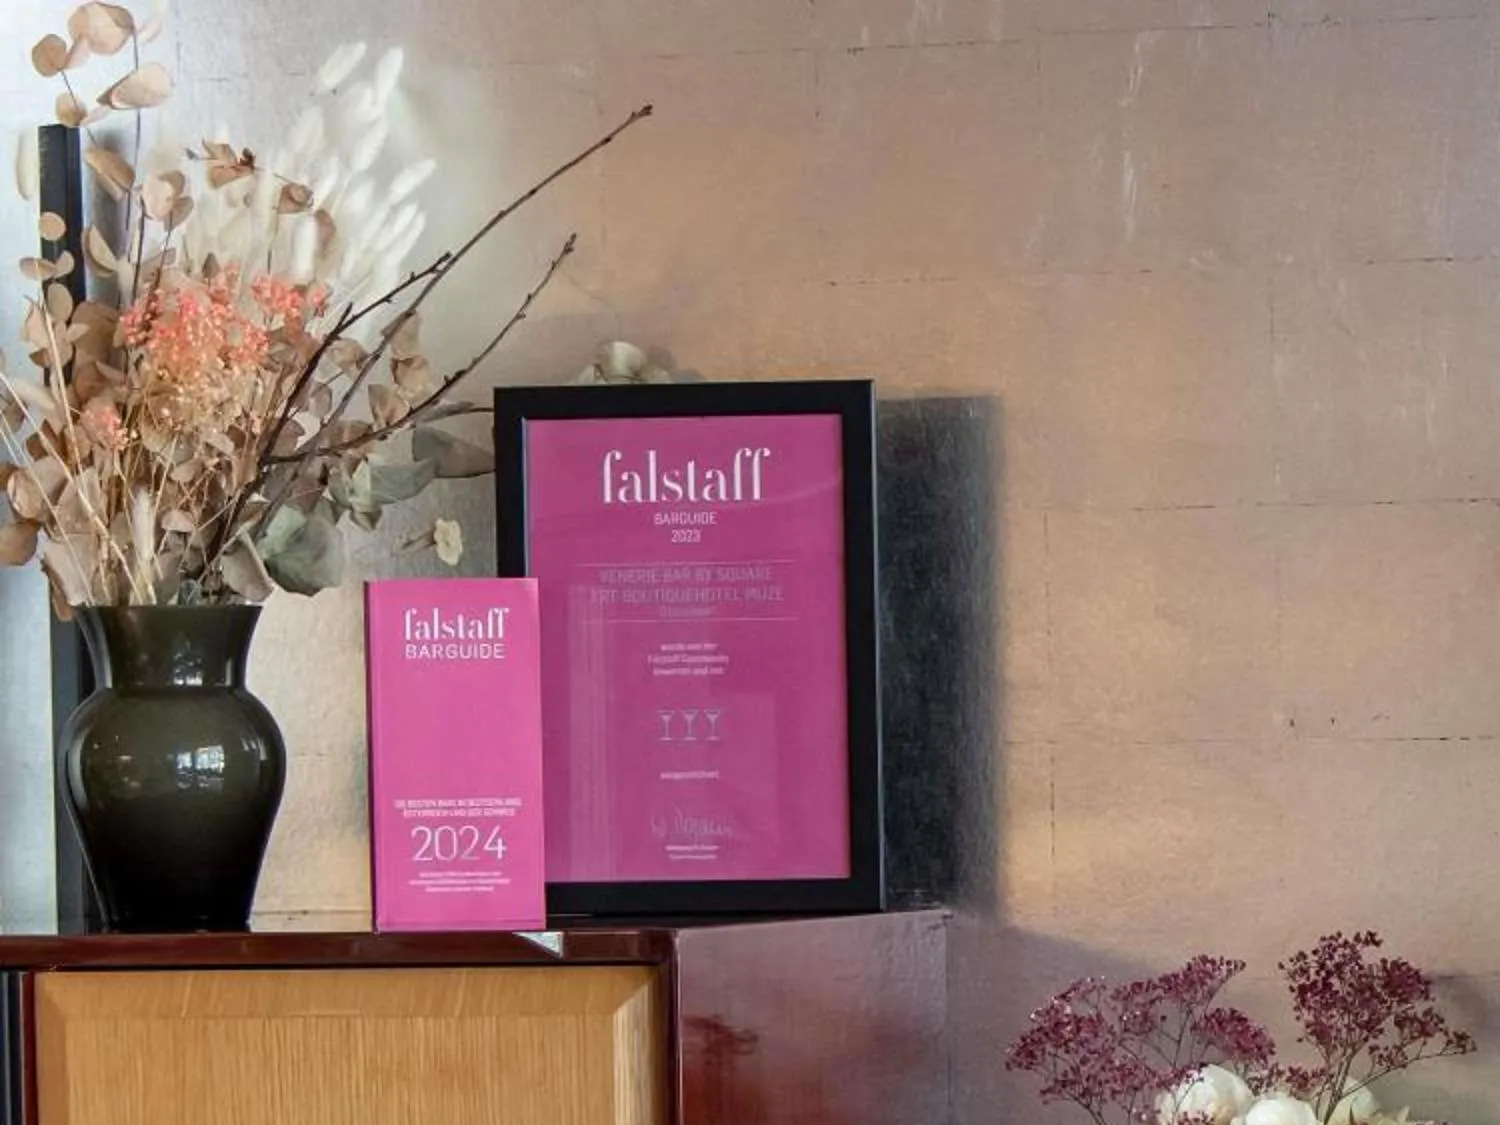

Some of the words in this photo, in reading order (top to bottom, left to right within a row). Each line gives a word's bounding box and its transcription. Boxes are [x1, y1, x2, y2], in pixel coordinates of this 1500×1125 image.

[603, 447, 771, 503] falstaff
[654, 511, 717, 526] BARGUIDE
[671, 529, 701, 543] 2023
[404, 607, 510, 640] falstaff
[405, 643, 506, 660] BARGUIDE
[411, 825, 507, 861] 2024
